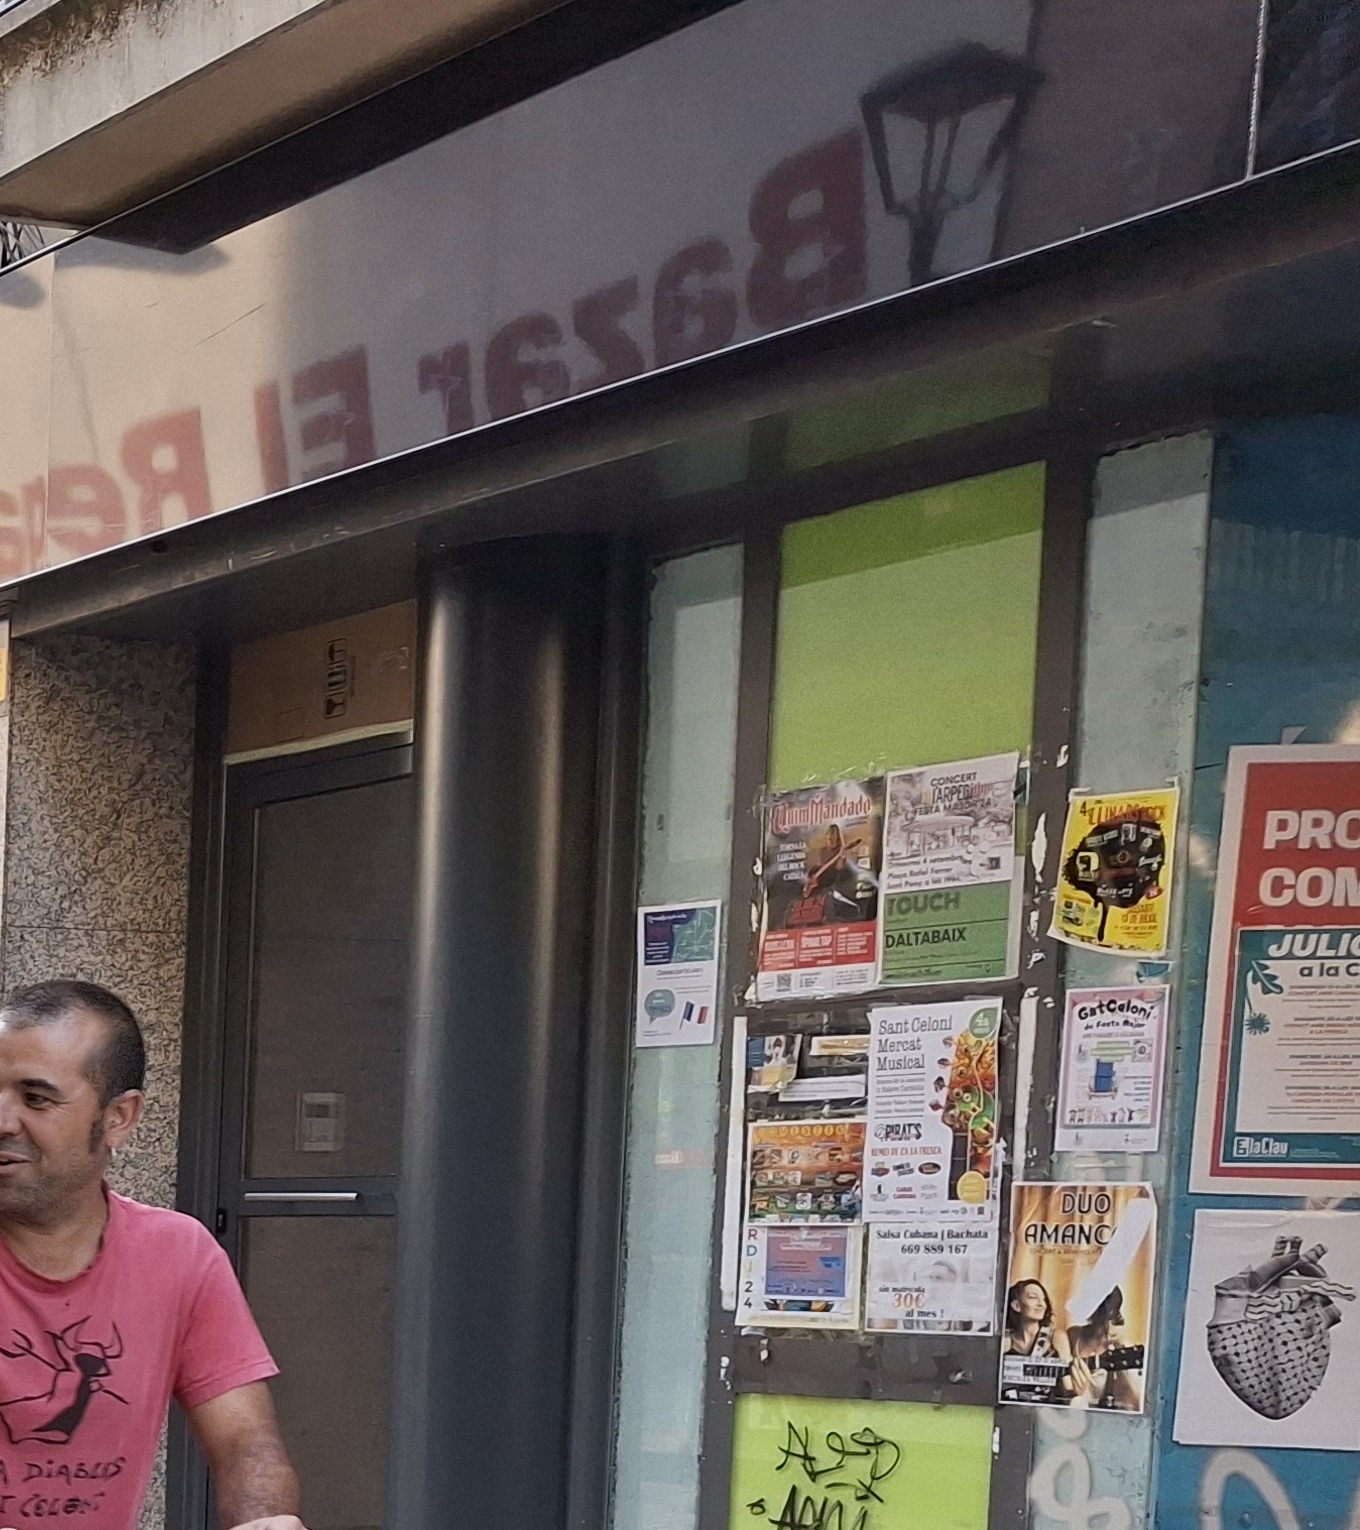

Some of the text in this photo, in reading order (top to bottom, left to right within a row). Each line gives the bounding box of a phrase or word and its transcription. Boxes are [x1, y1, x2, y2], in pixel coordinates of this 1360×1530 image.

[930, 771, 978, 787] CONCERT
[886, 891, 960, 916] TOUCH
[885, 927, 967, 948] DALTABAIX
[1299, 965, 1313, 977] a
[1319, 962, 1340, 977] la
[878, 1015, 954, 1035] Sant Celoni
[877, 1037, 922, 1053] Mercat
[876, 1054, 925, 1071] Musical
[1061, 1193, 1111, 1214] DUO
[876, 1229, 901, 1240] Salsa
[903, 1228, 939, 1239] Cubana
[947, 1228, 988, 1239] Bachata
[1024, 1223, 1117, 1245] AMANC
[900, 1244, 921, 1254] 669
[948, 1244, 968, 1254] 167
[892, 1292, 926, 1309] 30€
[917, 1310, 937, 1318] mes
